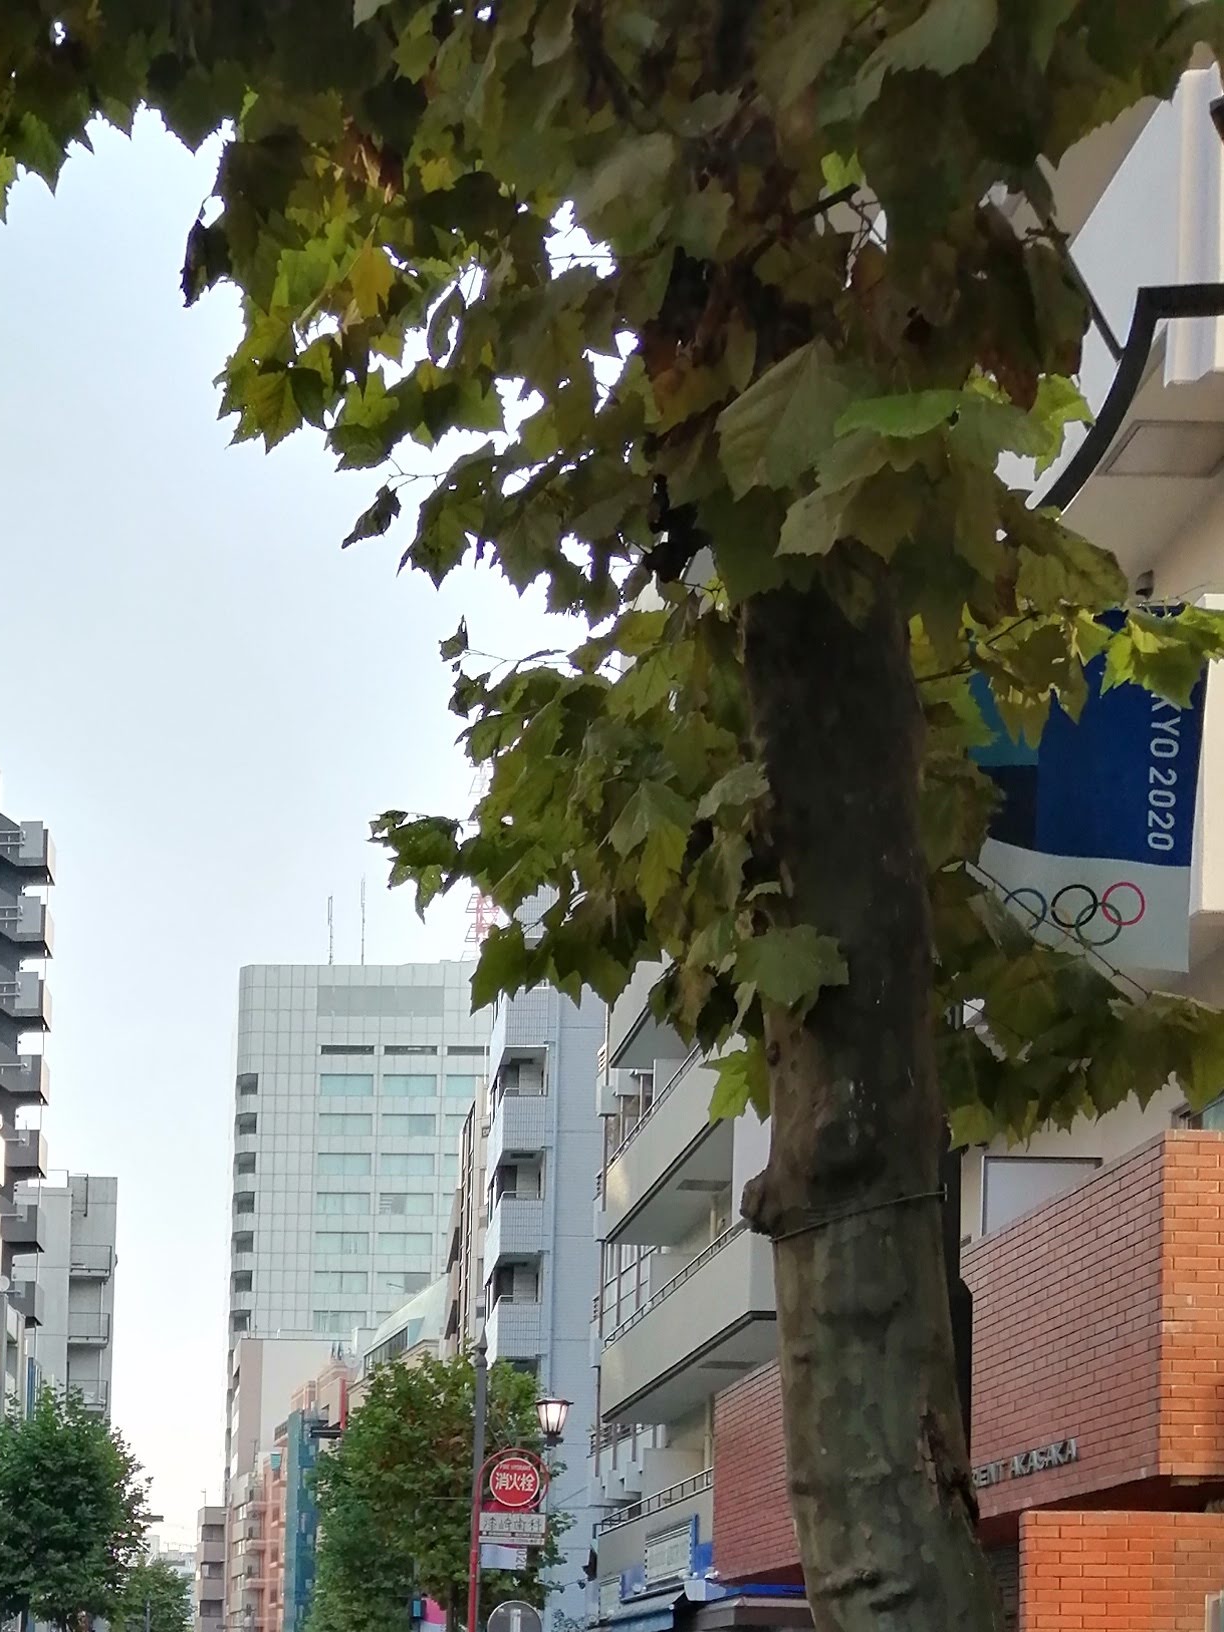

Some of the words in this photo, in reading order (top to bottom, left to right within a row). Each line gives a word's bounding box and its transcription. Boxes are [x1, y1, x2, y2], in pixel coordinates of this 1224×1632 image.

[1146, 767, 1178, 852] 2020
[1010, 1438, 1078, 1478] AKASAKA
[495, 1472, 535, 1492] 消火栓
